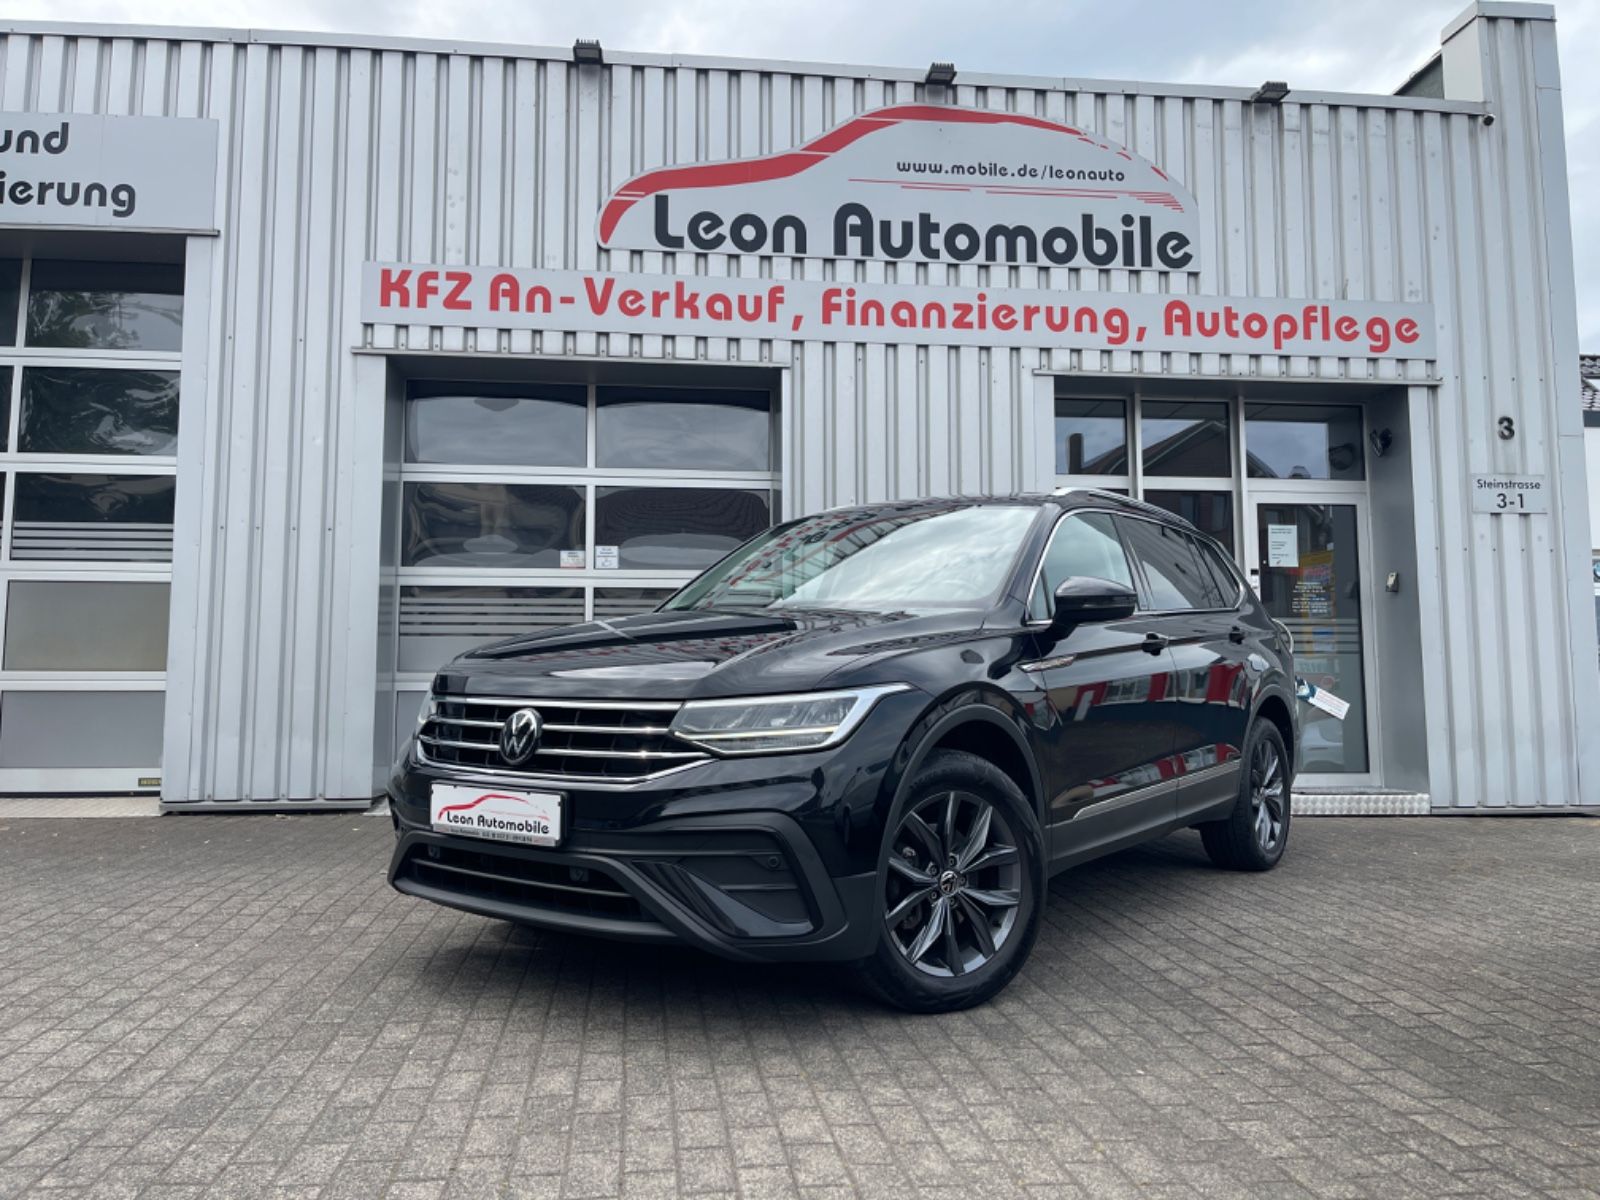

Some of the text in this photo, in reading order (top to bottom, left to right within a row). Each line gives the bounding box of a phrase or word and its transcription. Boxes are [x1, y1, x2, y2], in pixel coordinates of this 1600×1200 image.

[896, 160, 1125, 183] www.mobile.de/leonauto
[654, 194, 1194, 269] Leon Automobile
[821, 287, 1147, 346] Finanzierung,
[1163, 299, 1420, 354] Autopflege
[1498, 416, 1515, 441] 3
[1477, 479, 1541, 490] Steinstrasse
[1496, 493, 1524, 509] 3-1
[447, 811, 474, 826] Leon
[477, 815, 550, 834] Automobile
